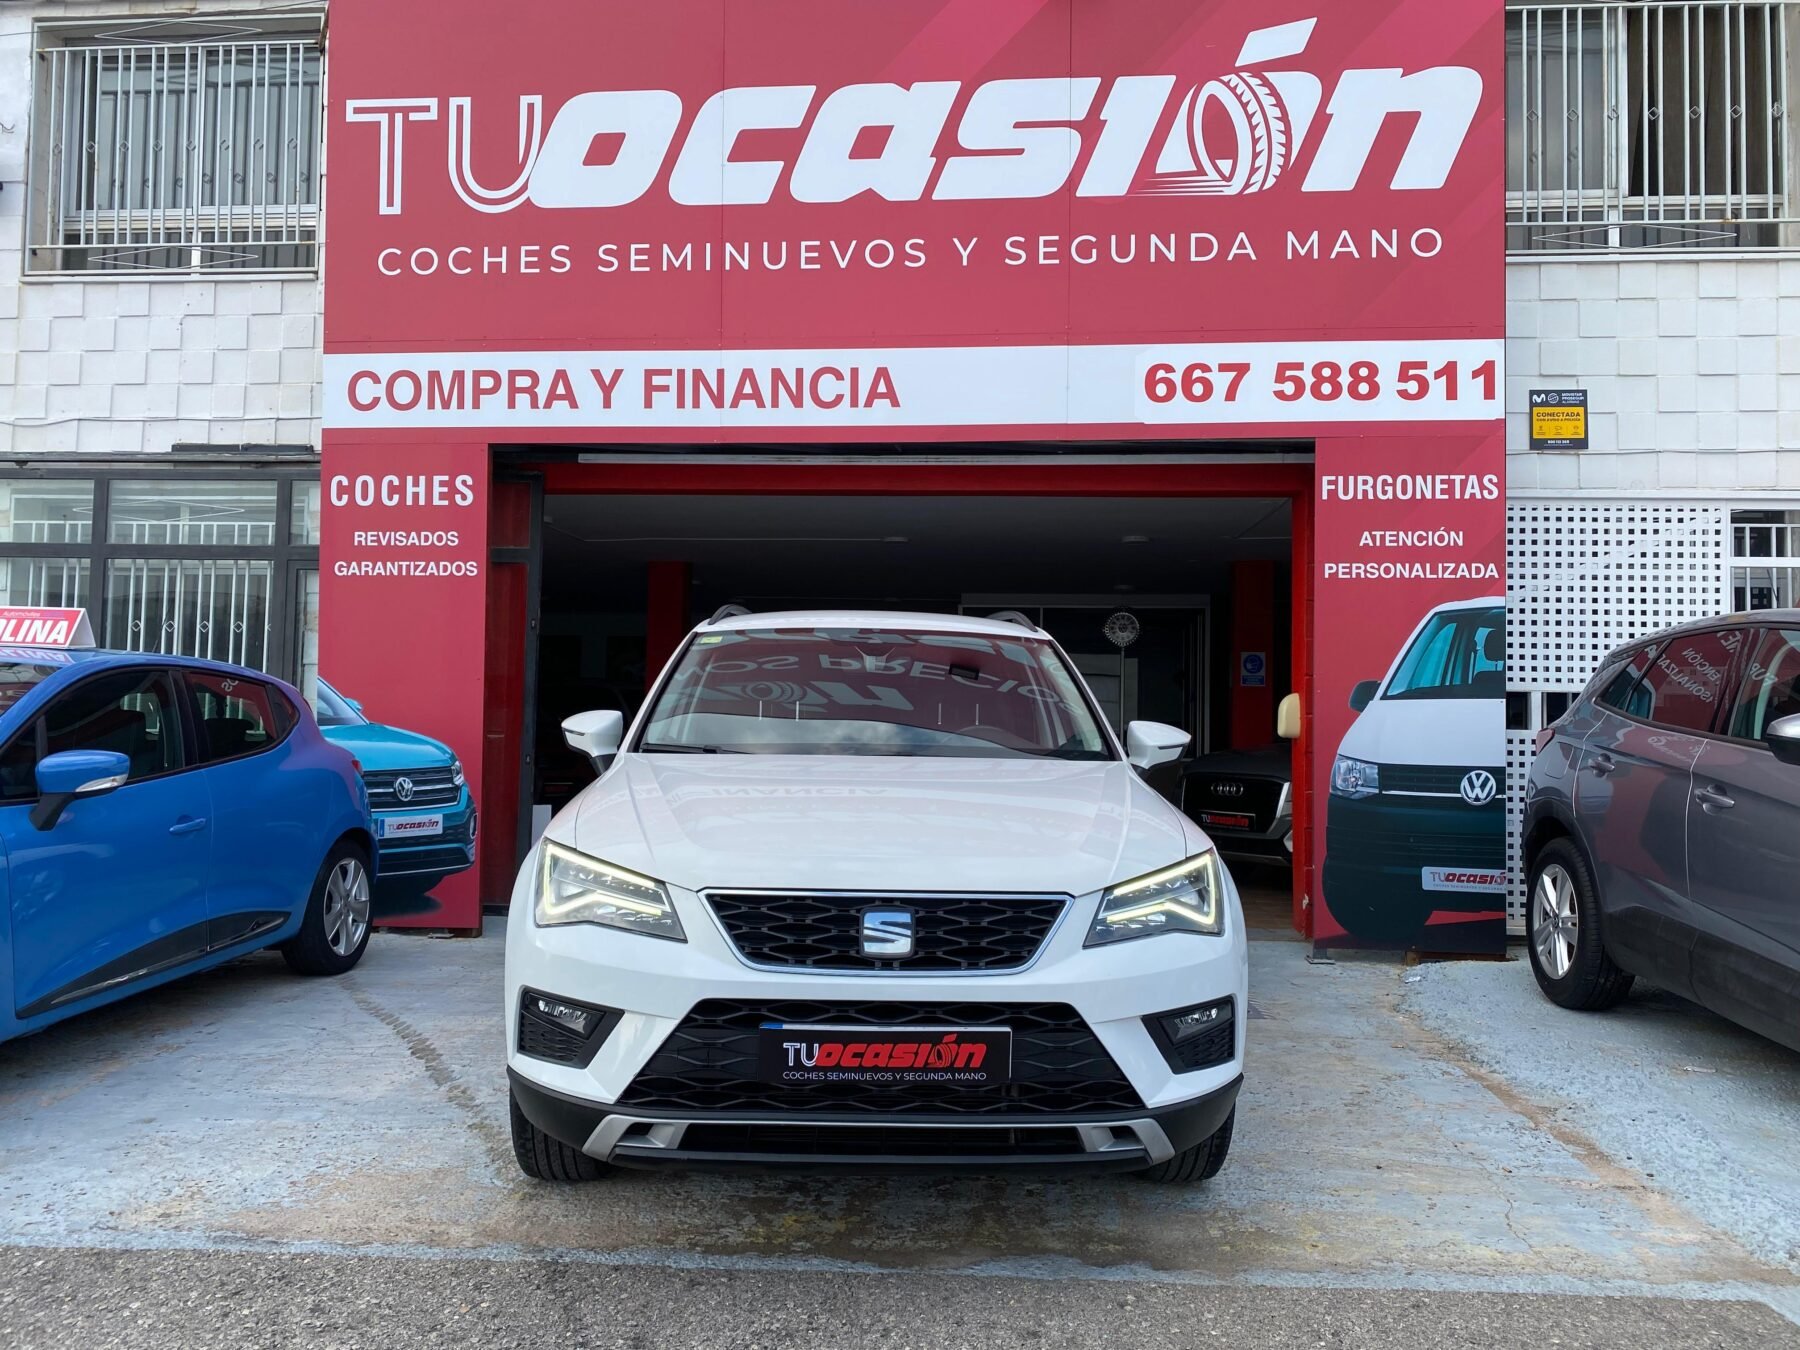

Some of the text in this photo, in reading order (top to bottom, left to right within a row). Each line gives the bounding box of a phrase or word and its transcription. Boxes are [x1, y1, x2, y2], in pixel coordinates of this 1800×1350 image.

[378, 228, 1443, 276] COCHES SEMINUEVOS Y SEGUNDA MANO
[348, 366, 901, 412] COMPRA Y FINANCIA
[1145, 360, 1496, 403] 667 588 511
[330, 474, 474, 507] COCHES
[1321, 473, 1499, 501] FURGONETAS
[354, 531, 459, 547] REVISADOS
[1359, 526, 1464, 547] ATENCIÓN
[334, 560, 478, 577] GARANTIZADOS
[1324, 562, 1499, 579] PERSONALIZADA
[783, 1071, 987, 1081] COCHES SEMINUEVOS Y SEGUNDA MANO
